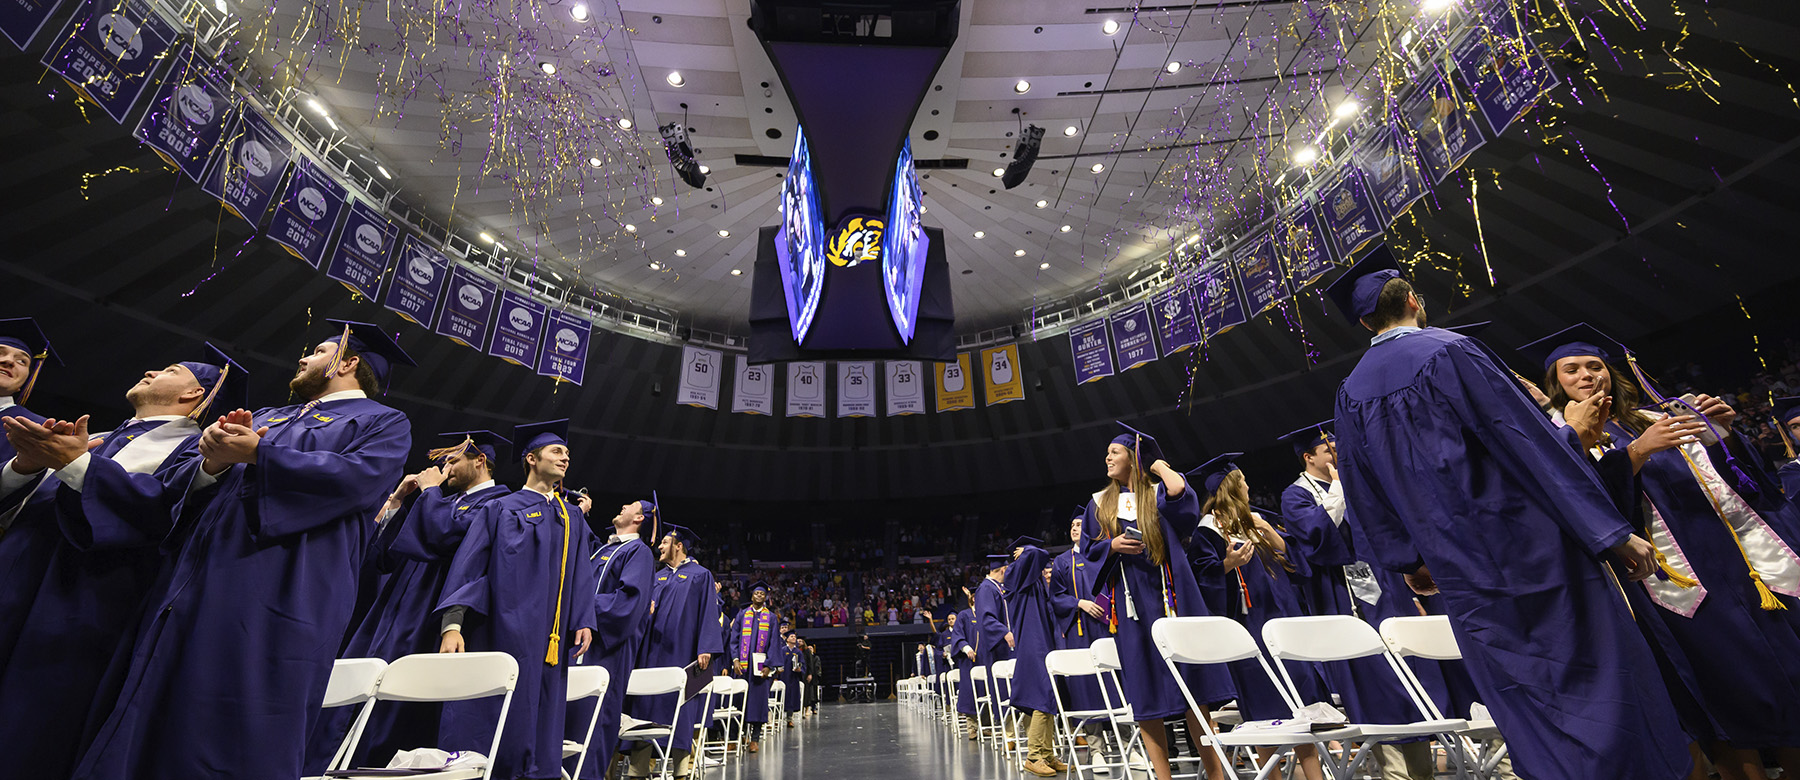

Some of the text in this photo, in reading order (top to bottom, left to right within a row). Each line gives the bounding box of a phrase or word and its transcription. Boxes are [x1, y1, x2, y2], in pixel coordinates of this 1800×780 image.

[101, 24, 138, 59] NCAA
[77, 46, 106, 73] SUPER
[162, 117, 185, 140] SUPER
[226, 183, 250, 206] 2013
[248, 188, 258, 199] SIX
[300, 197, 324, 218] NCAA
[287, 217, 316, 241] SUPER SIX
[286, 227, 310, 248] 2014
[357, 234, 380, 251] NCAA
[345, 257, 373, 277] SUPER SIX
[345, 266, 366, 284] 2016
[411, 266, 431, 282] NCAA
[400, 289, 416, 301] SUPER
[461, 294, 482, 307] NCAA
[400, 297, 420, 312] 2017
[451, 315, 477, 331] SUPER SIX
[511, 316, 531, 327] NCAA
[452, 323, 472, 337] 2018
[502, 336, 529, 350] FINAL FOUR
[558, 337, 578, 348] NCAA
[1078, 338, 1102, 351] GUNTER
[1083, 335, 1094, 343] SUE
[504, 344, 524, 357] 2019
[1128, 348, 1143, 359] 1977
[695, 363, 708, 373] 50
[995, 360, 1007, 371] 34
[748, 371, 761, 381] 23
[801, 376, 812, 384] 40
[898, 374, 910, 383] 33
[947, 369, 959, 378] 33
[851, 376, 862, 385] 35
